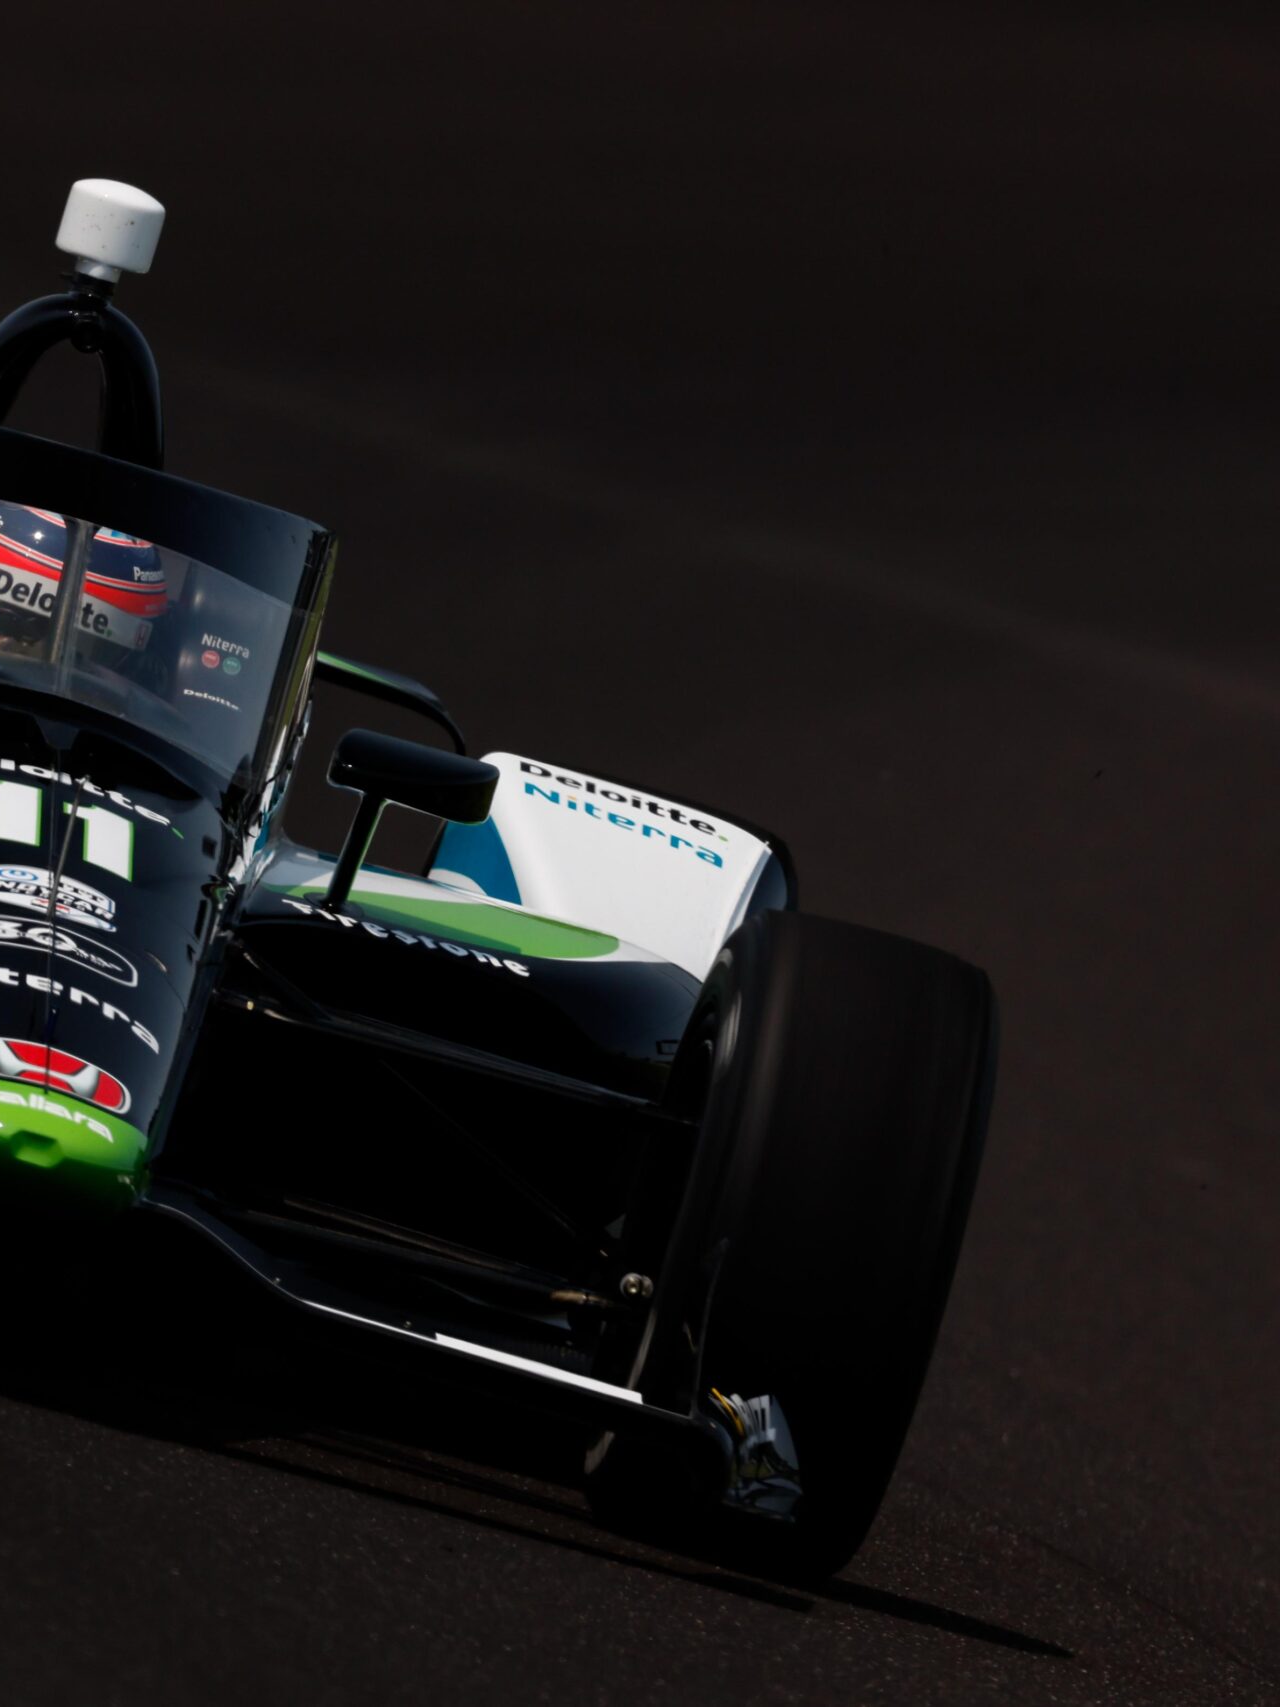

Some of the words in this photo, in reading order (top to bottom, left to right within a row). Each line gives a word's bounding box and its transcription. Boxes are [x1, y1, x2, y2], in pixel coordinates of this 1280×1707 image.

[201, 633, 251, 660] Niterra
[519, 761, 729, 842] Deloitte.
[524, 782, 724, 869] Niterra
[281, 898, 531, 978] Firestone
